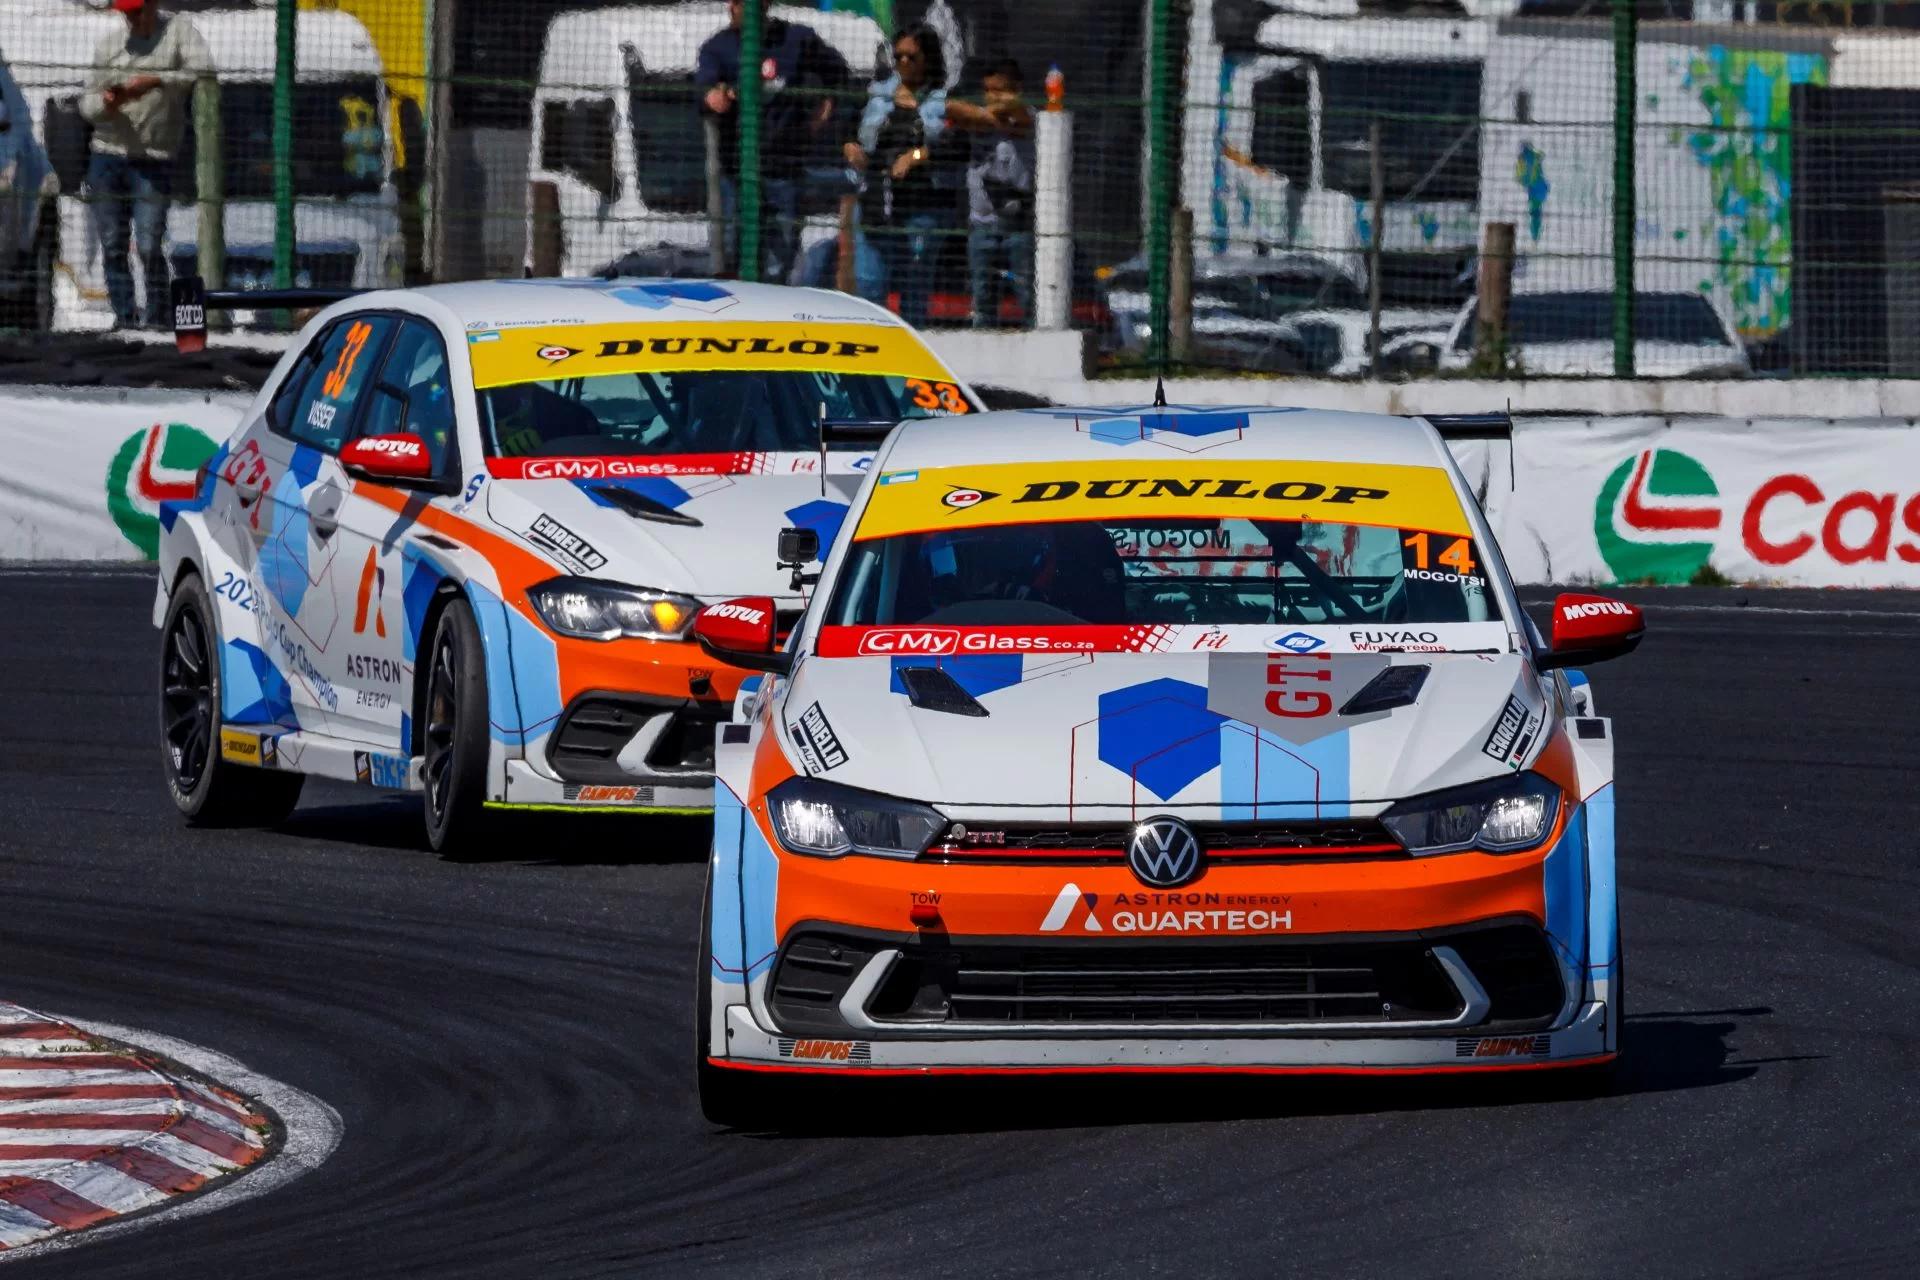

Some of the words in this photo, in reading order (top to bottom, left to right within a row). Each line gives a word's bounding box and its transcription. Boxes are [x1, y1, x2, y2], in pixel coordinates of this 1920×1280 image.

[595, 337, 880, 358] DUNLOP
[322, 320, 373, 399] 33
[906, 378, 969, 415] 33
[307, 400, 336, 430] VISSER
[356, 438, 420, 457] MOTUL
[1010, 479, 1391, 505] DUNLOP
[532, 516, 605, 570] CARELLO
[1404, 532, 1476, 575] 14
[1404, 568, 1486, 587] MOGOTSI
[703, 603, 766, 625] MOTUL
[1562, 602, 1633, 621] MOTUL
[1349, 631, 1439, 644] FUYAO
[297, 644, 338, 713] Champion
[347, 653, 401, 684] ASTRON
[356, 690, 392, 710] ENERGY
[803, 702, 847, 770] CARELLO
[1486, 698, 1528, 760] CARELLO
[372, 752, 409, 788] SKF
[801, 746, 822, 774] AUTO
[577, 786, 640, 801] CAMPOS
[910, 892, 942, 905] TOW
[1113, 892, 1221, 906] ASTRON
[1225, 895, 1292, 906] ENERGY
[1112, 910, 1292, 932] QUARTECH
[793, 1039, 853, 1060] CAMPOS
[1474, 1035, 1538, 1057] CAMPOS
